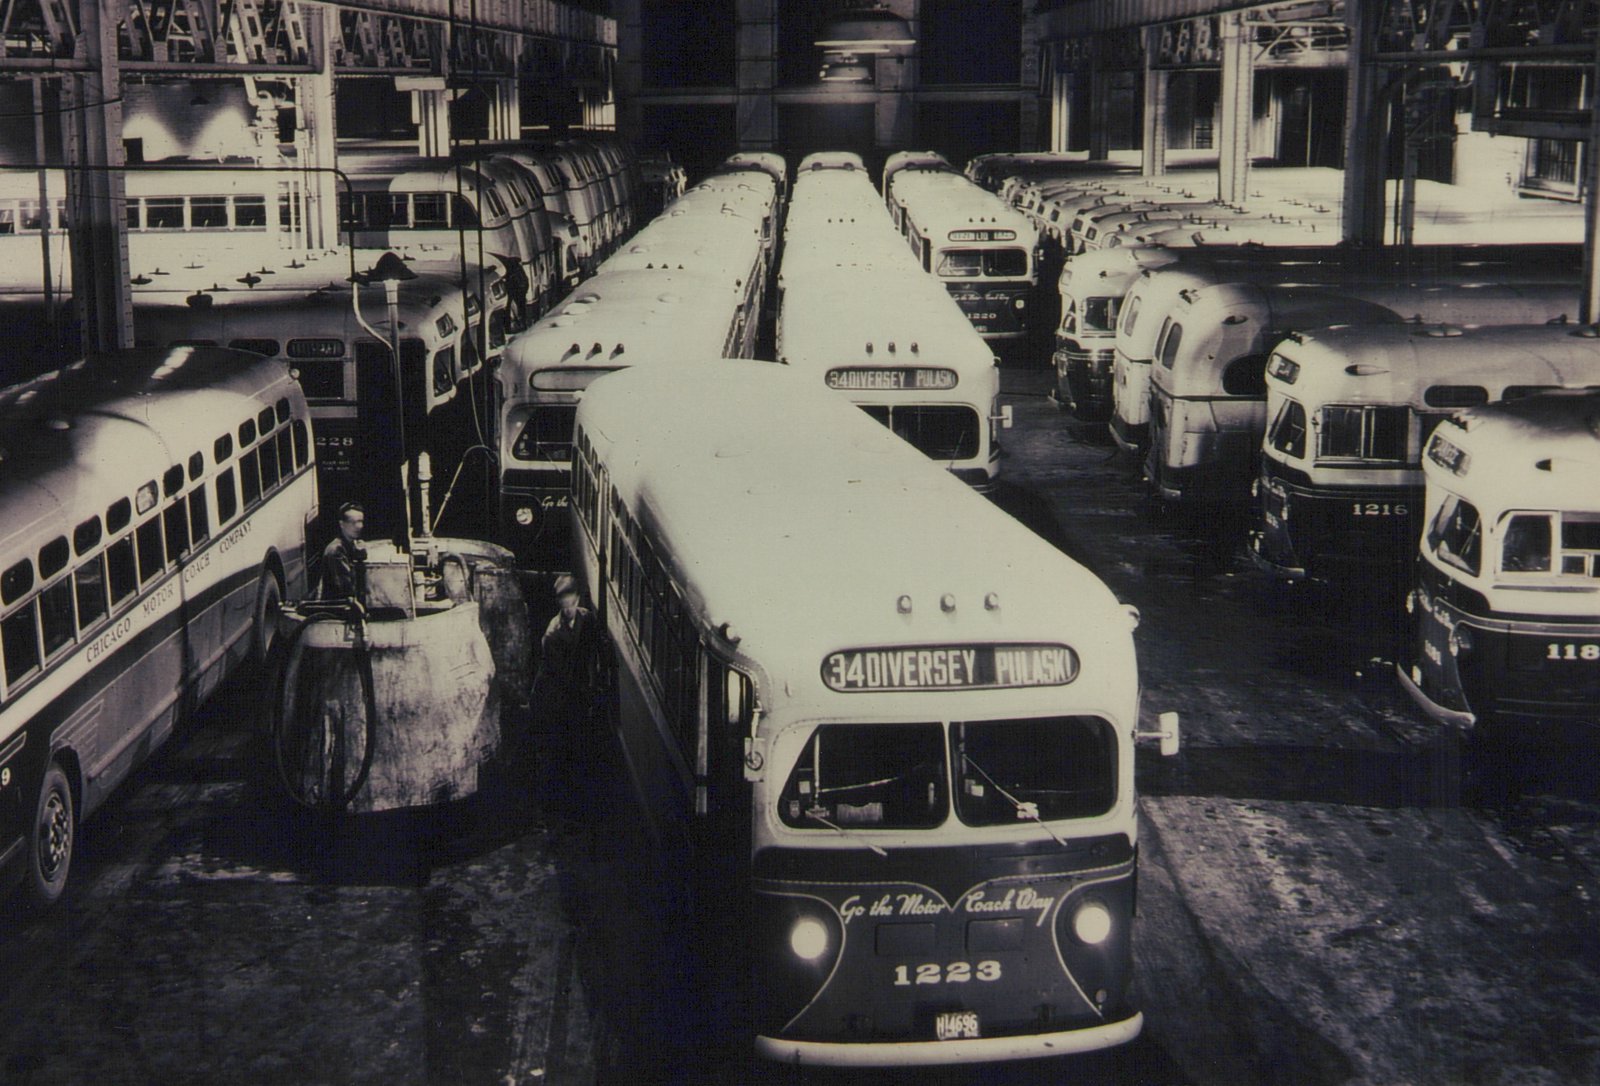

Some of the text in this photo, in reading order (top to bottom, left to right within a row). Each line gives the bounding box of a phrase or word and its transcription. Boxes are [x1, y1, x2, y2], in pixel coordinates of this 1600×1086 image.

[967, 312, 997, 320] 1220
[848, 370, 906, 388] DIVERSEY
[1352, 503, 1408, 516] 1216
[86, 521, 253, 663] CHICAGO MOTOR COACH COMPANY
[829, 649, 1072, 688] 34 DIVERSEY PULASKI
[839, 887, 1055, 927] Go the Motor Coach Way
[893, 960, 1002, 986] 1223
